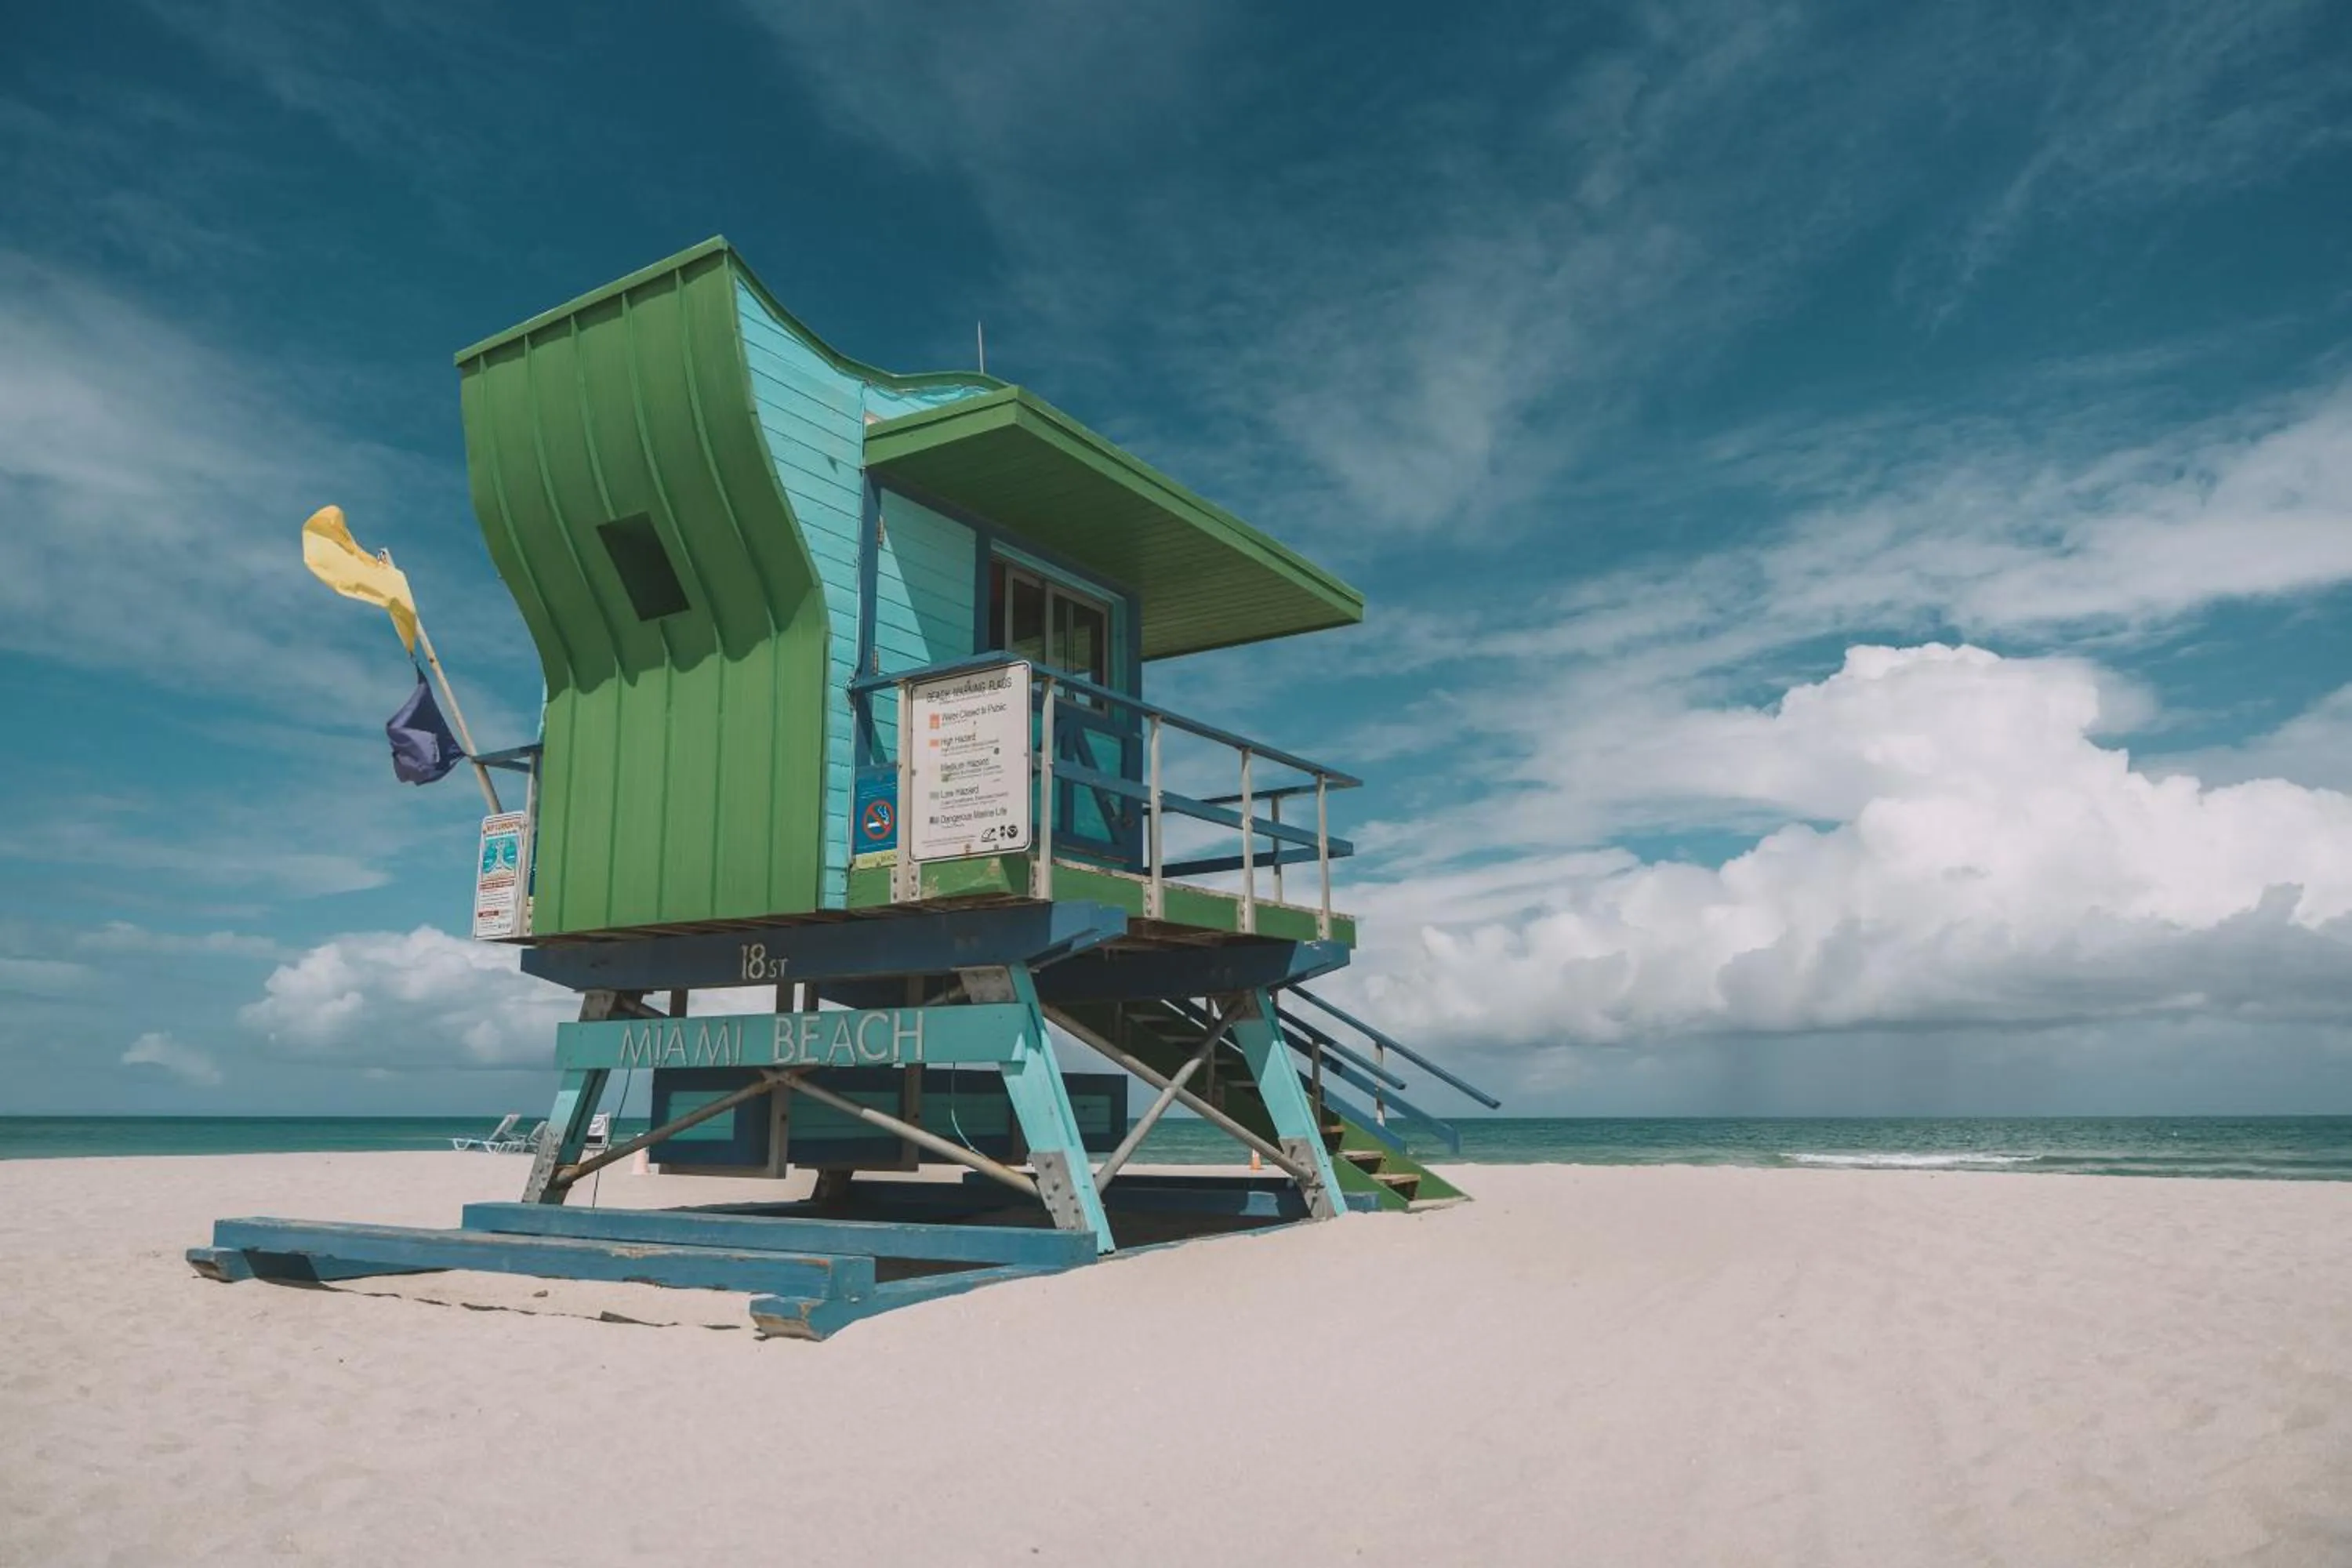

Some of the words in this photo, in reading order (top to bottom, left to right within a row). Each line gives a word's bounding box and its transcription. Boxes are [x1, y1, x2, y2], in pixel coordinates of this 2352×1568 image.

[988, 702, 1007, 715] Public
[741, 943, 766, 980] 18
[768, 957, 789, 978] ST
[619, 1021, 744, 1067] MIAMI
[772, 1010, 924, 1067] BEACH
